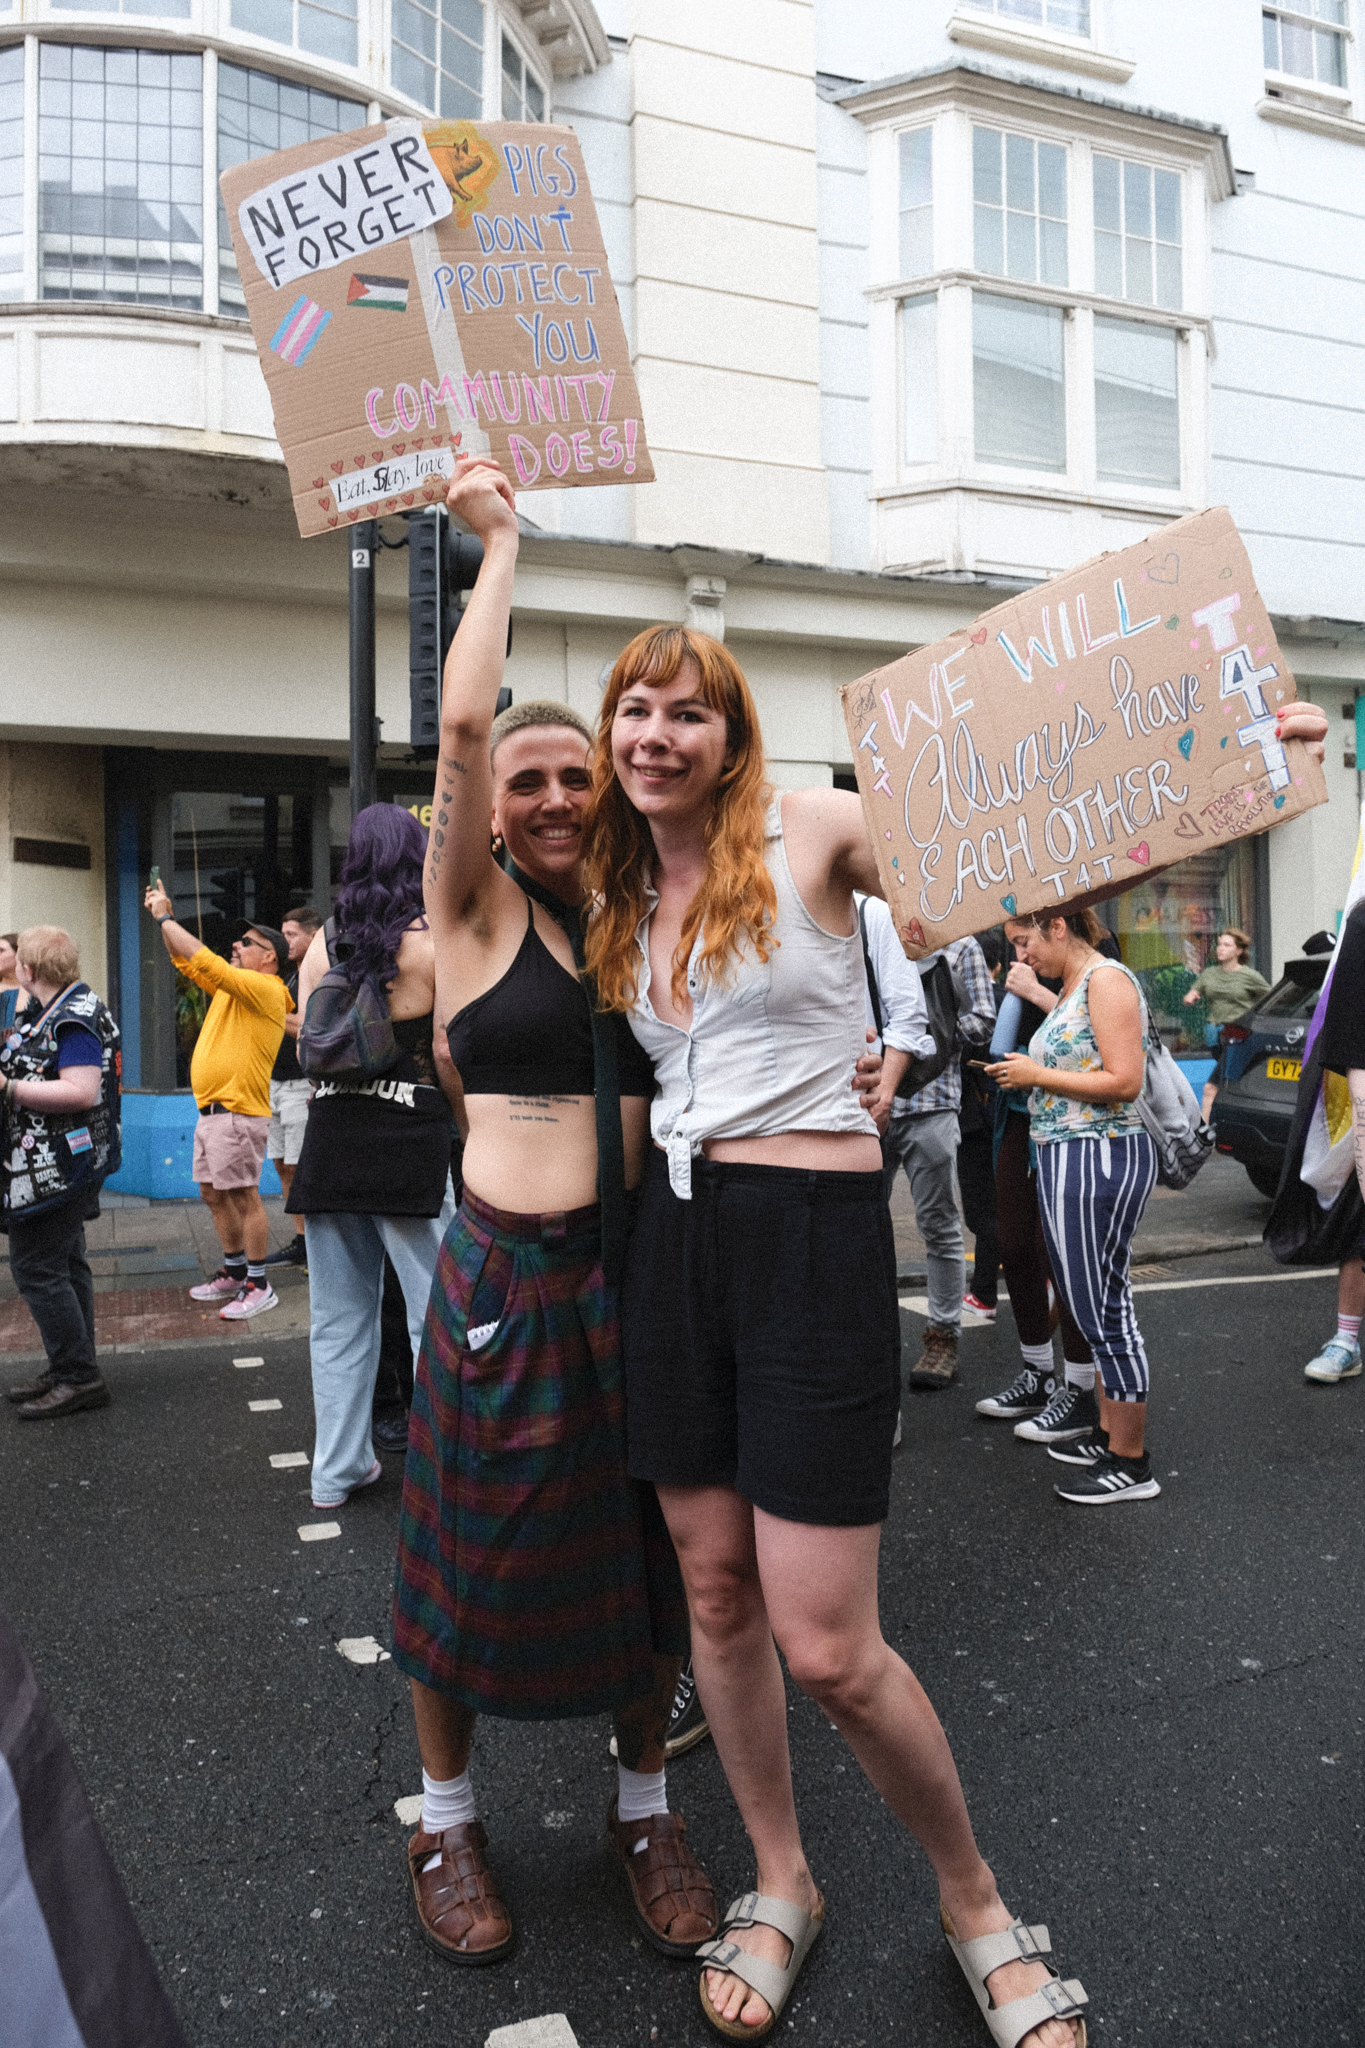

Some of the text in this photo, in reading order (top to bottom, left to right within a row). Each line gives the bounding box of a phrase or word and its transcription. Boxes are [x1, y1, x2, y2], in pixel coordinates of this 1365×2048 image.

[247, 136, 430, 247] NEVER
[503, 143, 577, 197] PIGS
[264, 179, 437, 288] FORGET
[472, 202, 573, 255] DON'T
[433, 261, 601, 313] PROTECT
[515, 311, 602, 369] YOU
[365, 369, 616, 438] COMMUNITY
[337, 478, 371, 502] Eat,
[415, 454, 444, 477] love
[507, 418, 638, 486] DOES!
[356, 552, 366, 565] 2
[880, 577, 1162, 750] WE WILL
[904, 654, 1206, 849] Always have
[919, 758, 1190, 923] EACH OTHER
